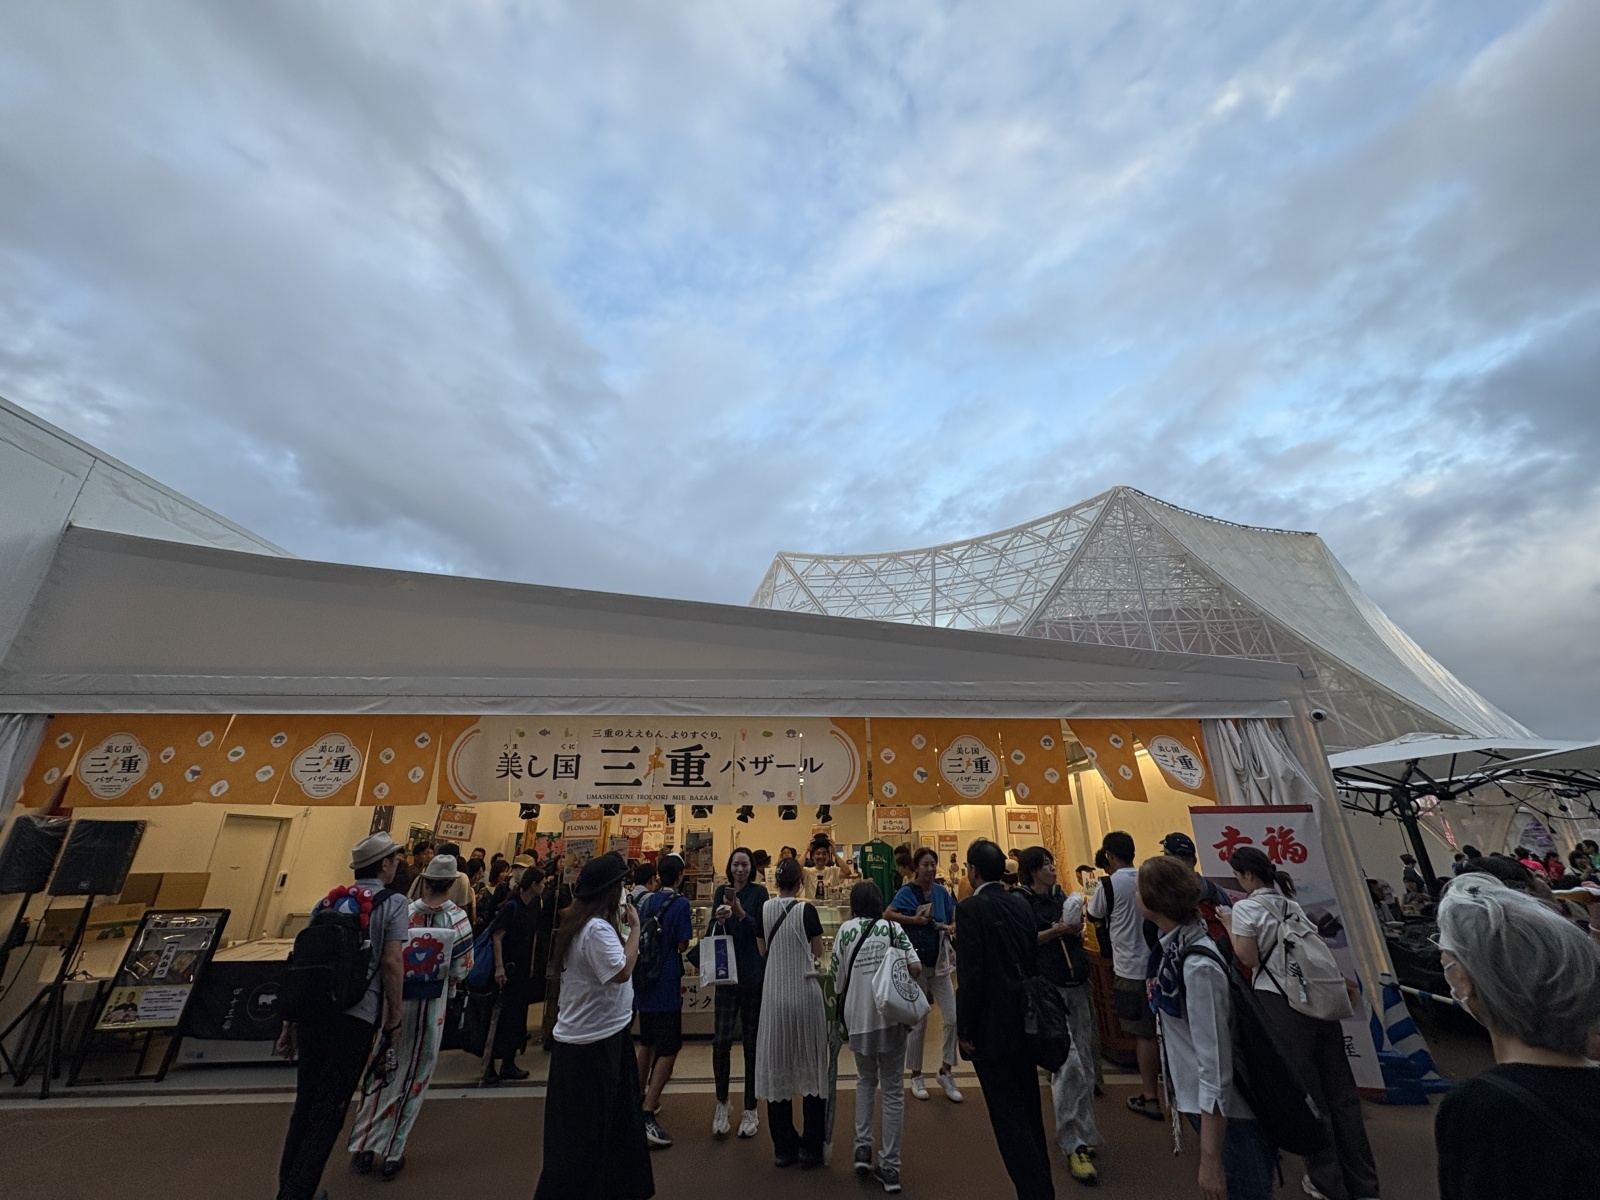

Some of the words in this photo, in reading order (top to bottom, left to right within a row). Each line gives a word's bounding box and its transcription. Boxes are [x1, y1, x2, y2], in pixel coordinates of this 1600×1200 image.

[592, 728, 723, 741] 三重のええもん、よりすぐり。
[104, 745, 133, 753] 美し国
[318, 745, 345, 753] 美し国
[957, 747, 980, 755] 美し国
[86, 754, 142, 774] 三重
[300, 754, 353, 773] 三重
[495, 752, 582, 781] 美し国
[594, 743, 712, 789] 三重
[719, 754, 825, 777] バザール
[946, 756, 992, 774] 三重
